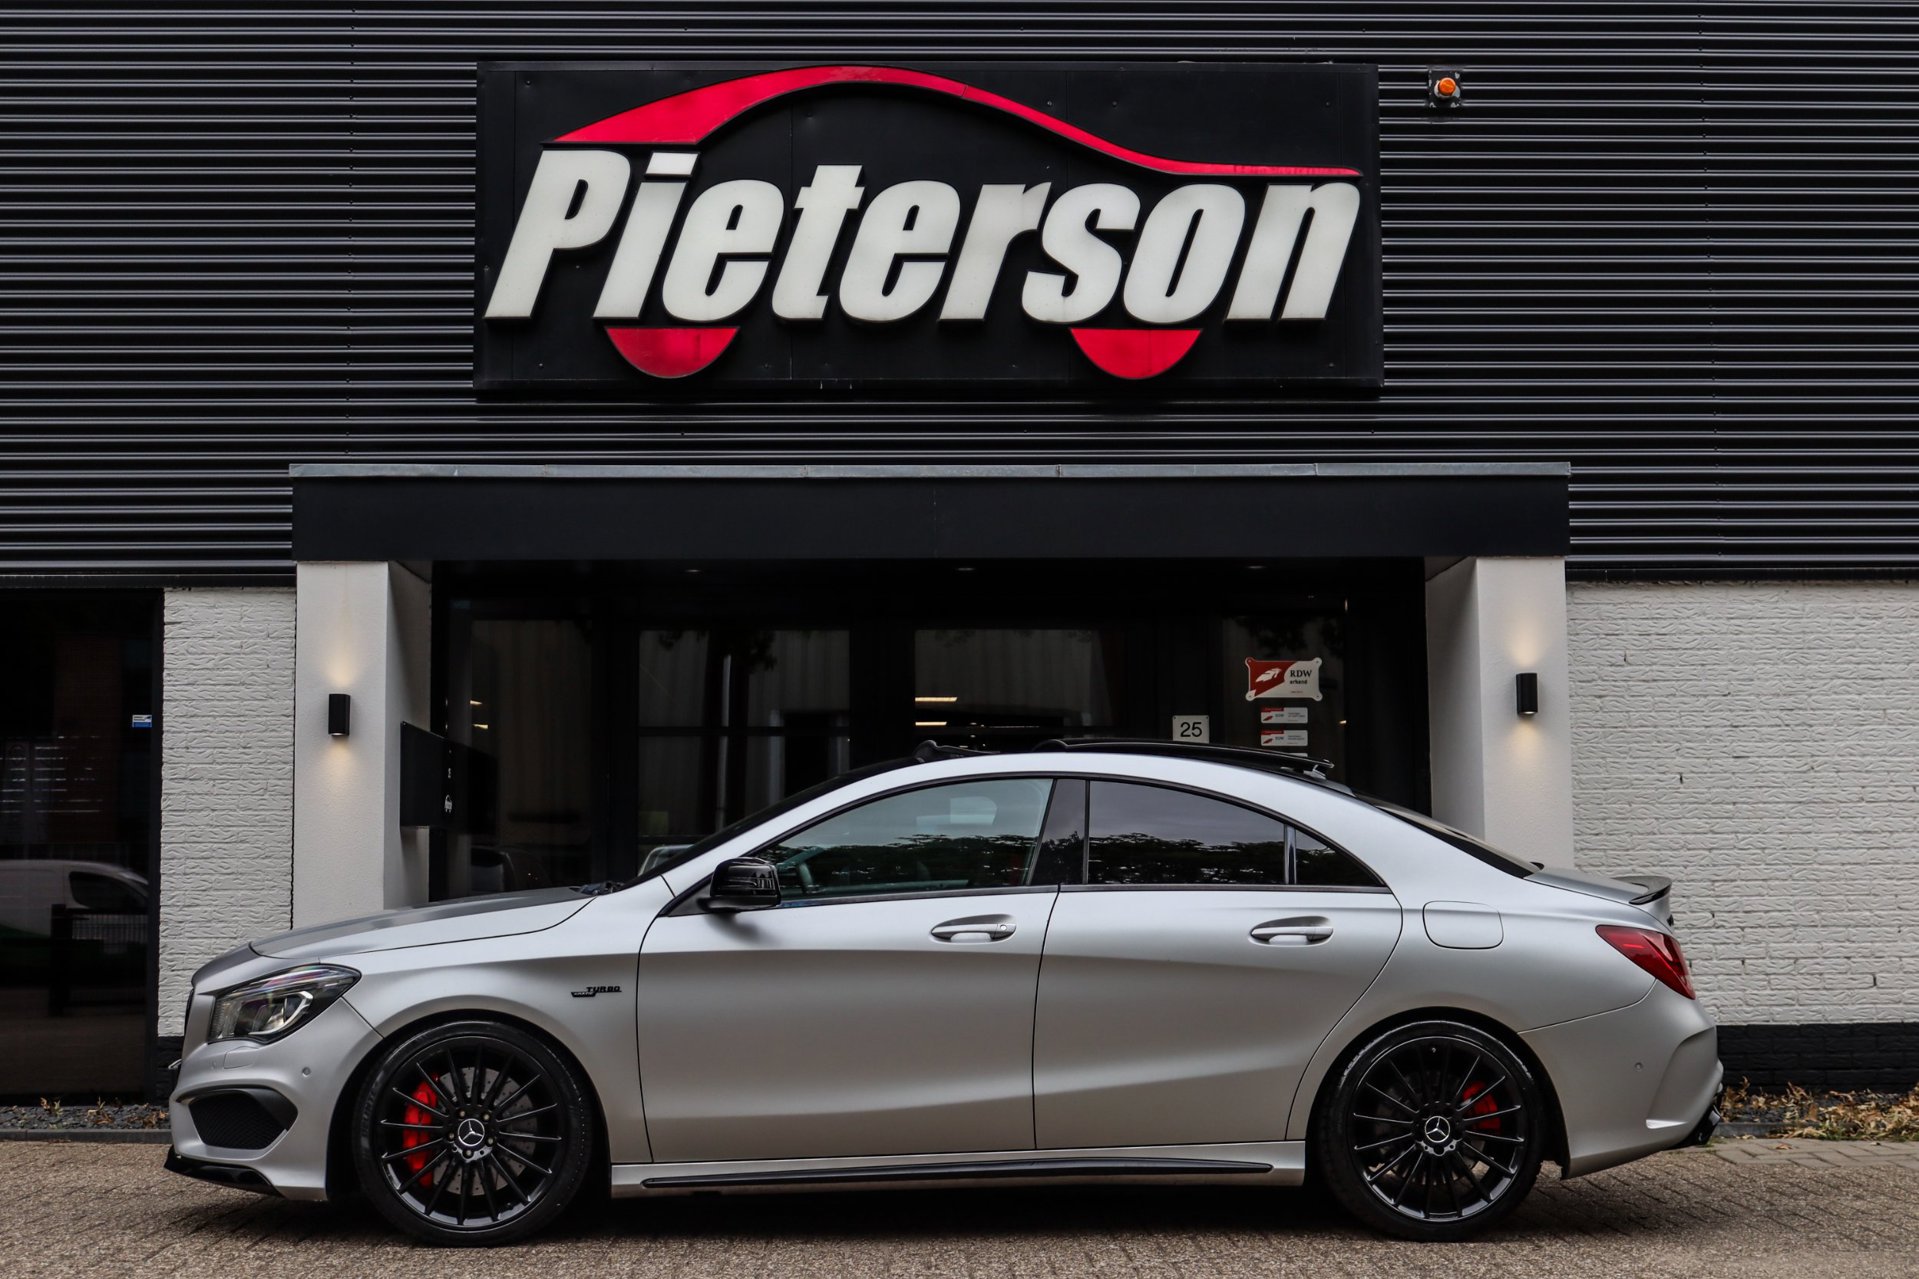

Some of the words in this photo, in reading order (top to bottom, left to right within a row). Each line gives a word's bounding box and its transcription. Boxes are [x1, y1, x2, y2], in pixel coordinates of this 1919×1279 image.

[485, 150, 1361, 323] Pieterson
[1289, 669, 1312, 678] RDW
[1180, 721, 1202, 738] 25
[586, 985, 621, 993] TURBO
